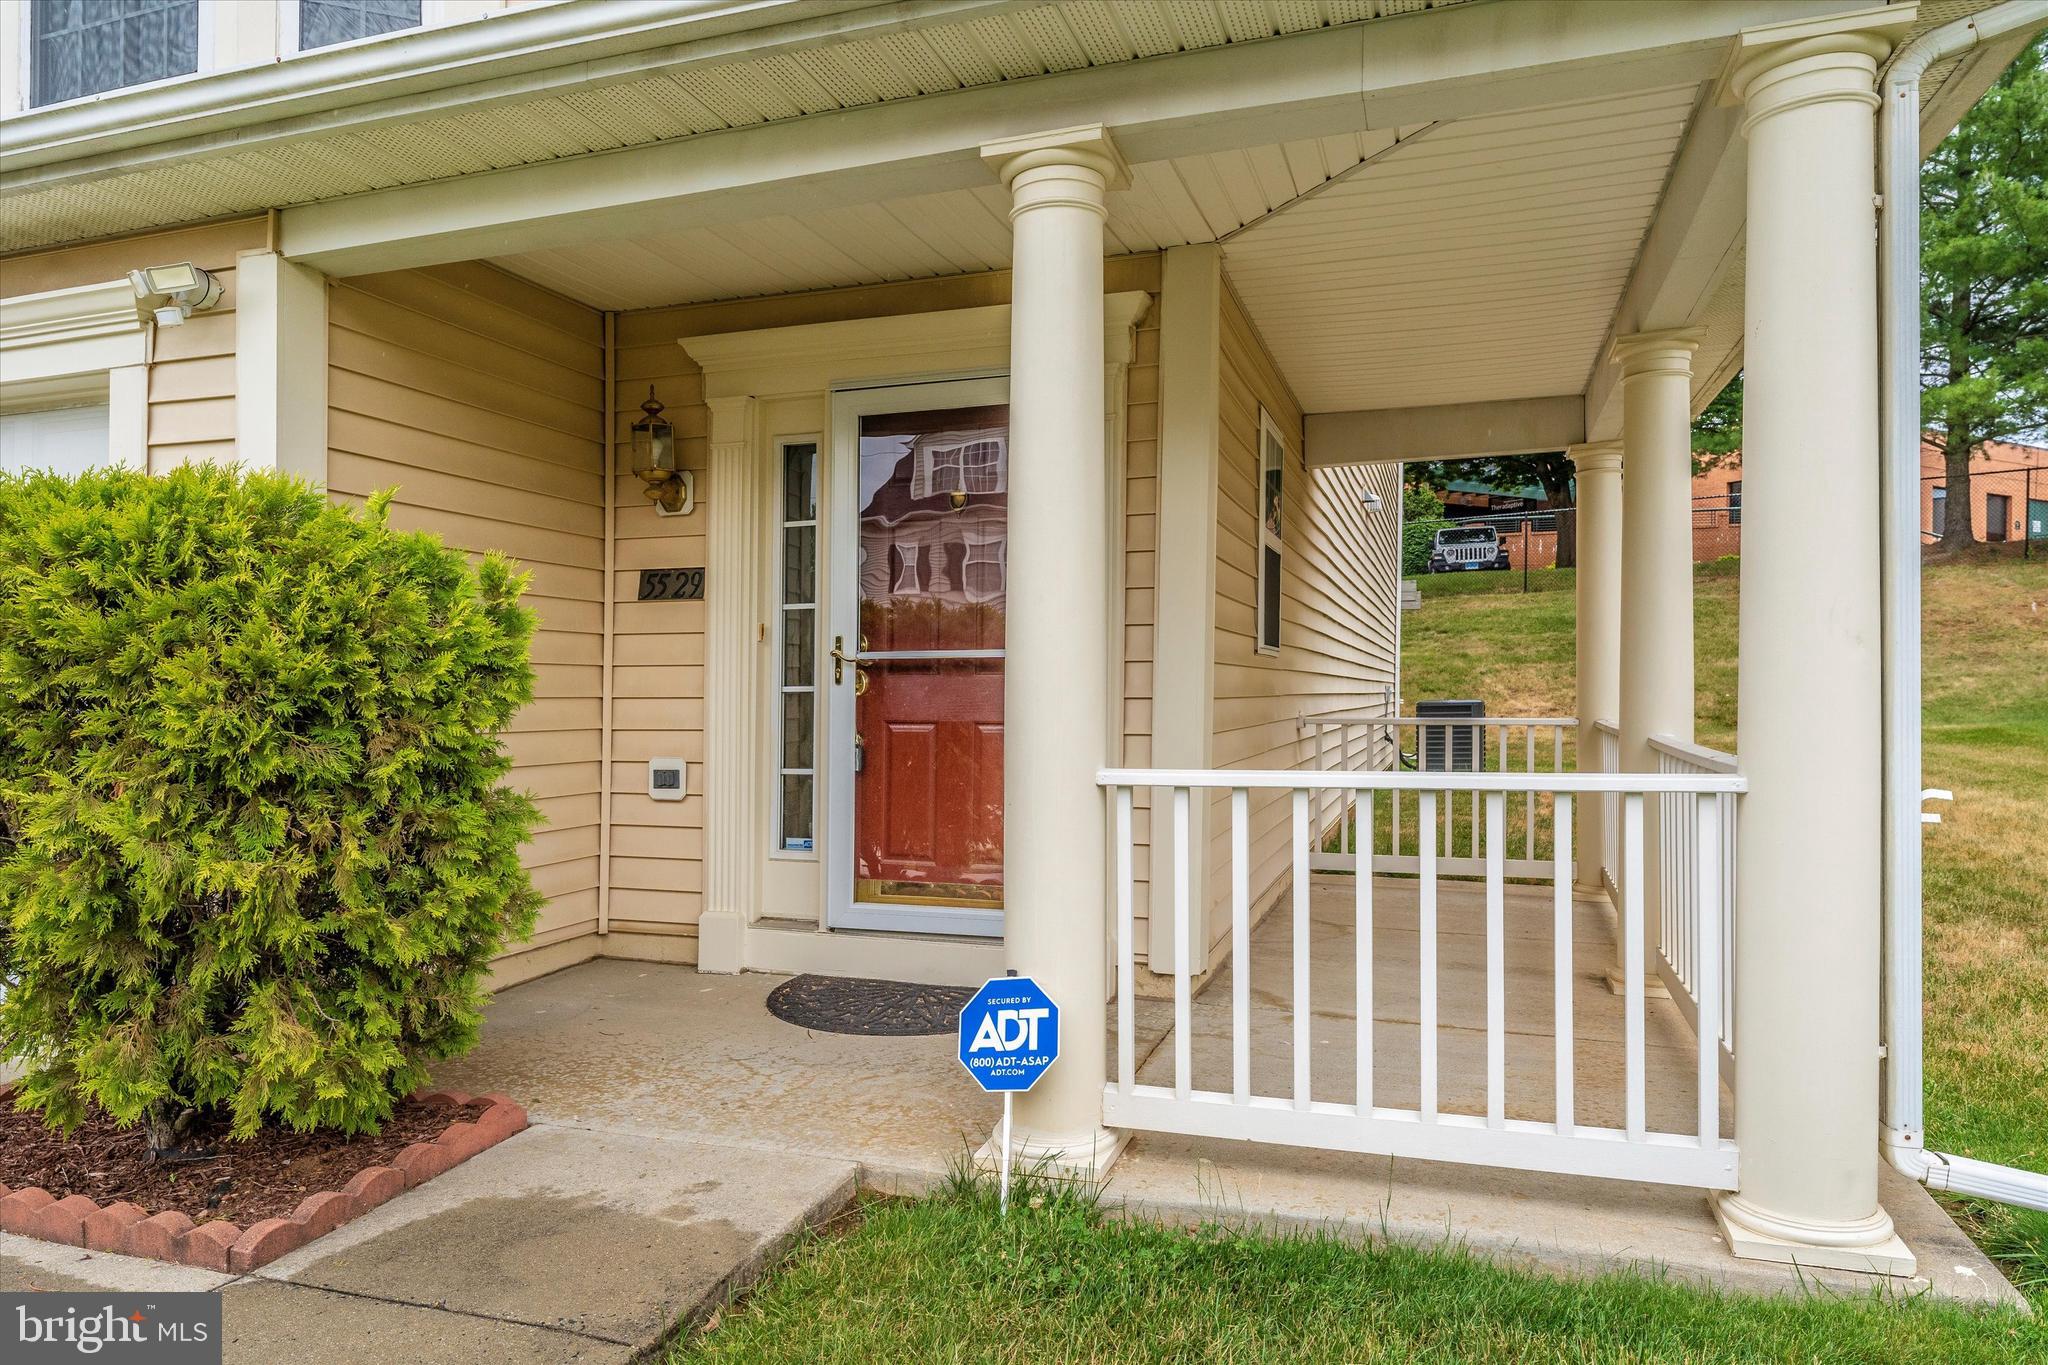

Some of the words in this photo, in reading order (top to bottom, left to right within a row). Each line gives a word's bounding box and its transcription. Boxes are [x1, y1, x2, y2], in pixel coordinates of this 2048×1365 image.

[642, 571, 702, 598] 5529
[987, 997, 1020, 1005] SECURED
[968, 1008, 1049, 1052] ADT
